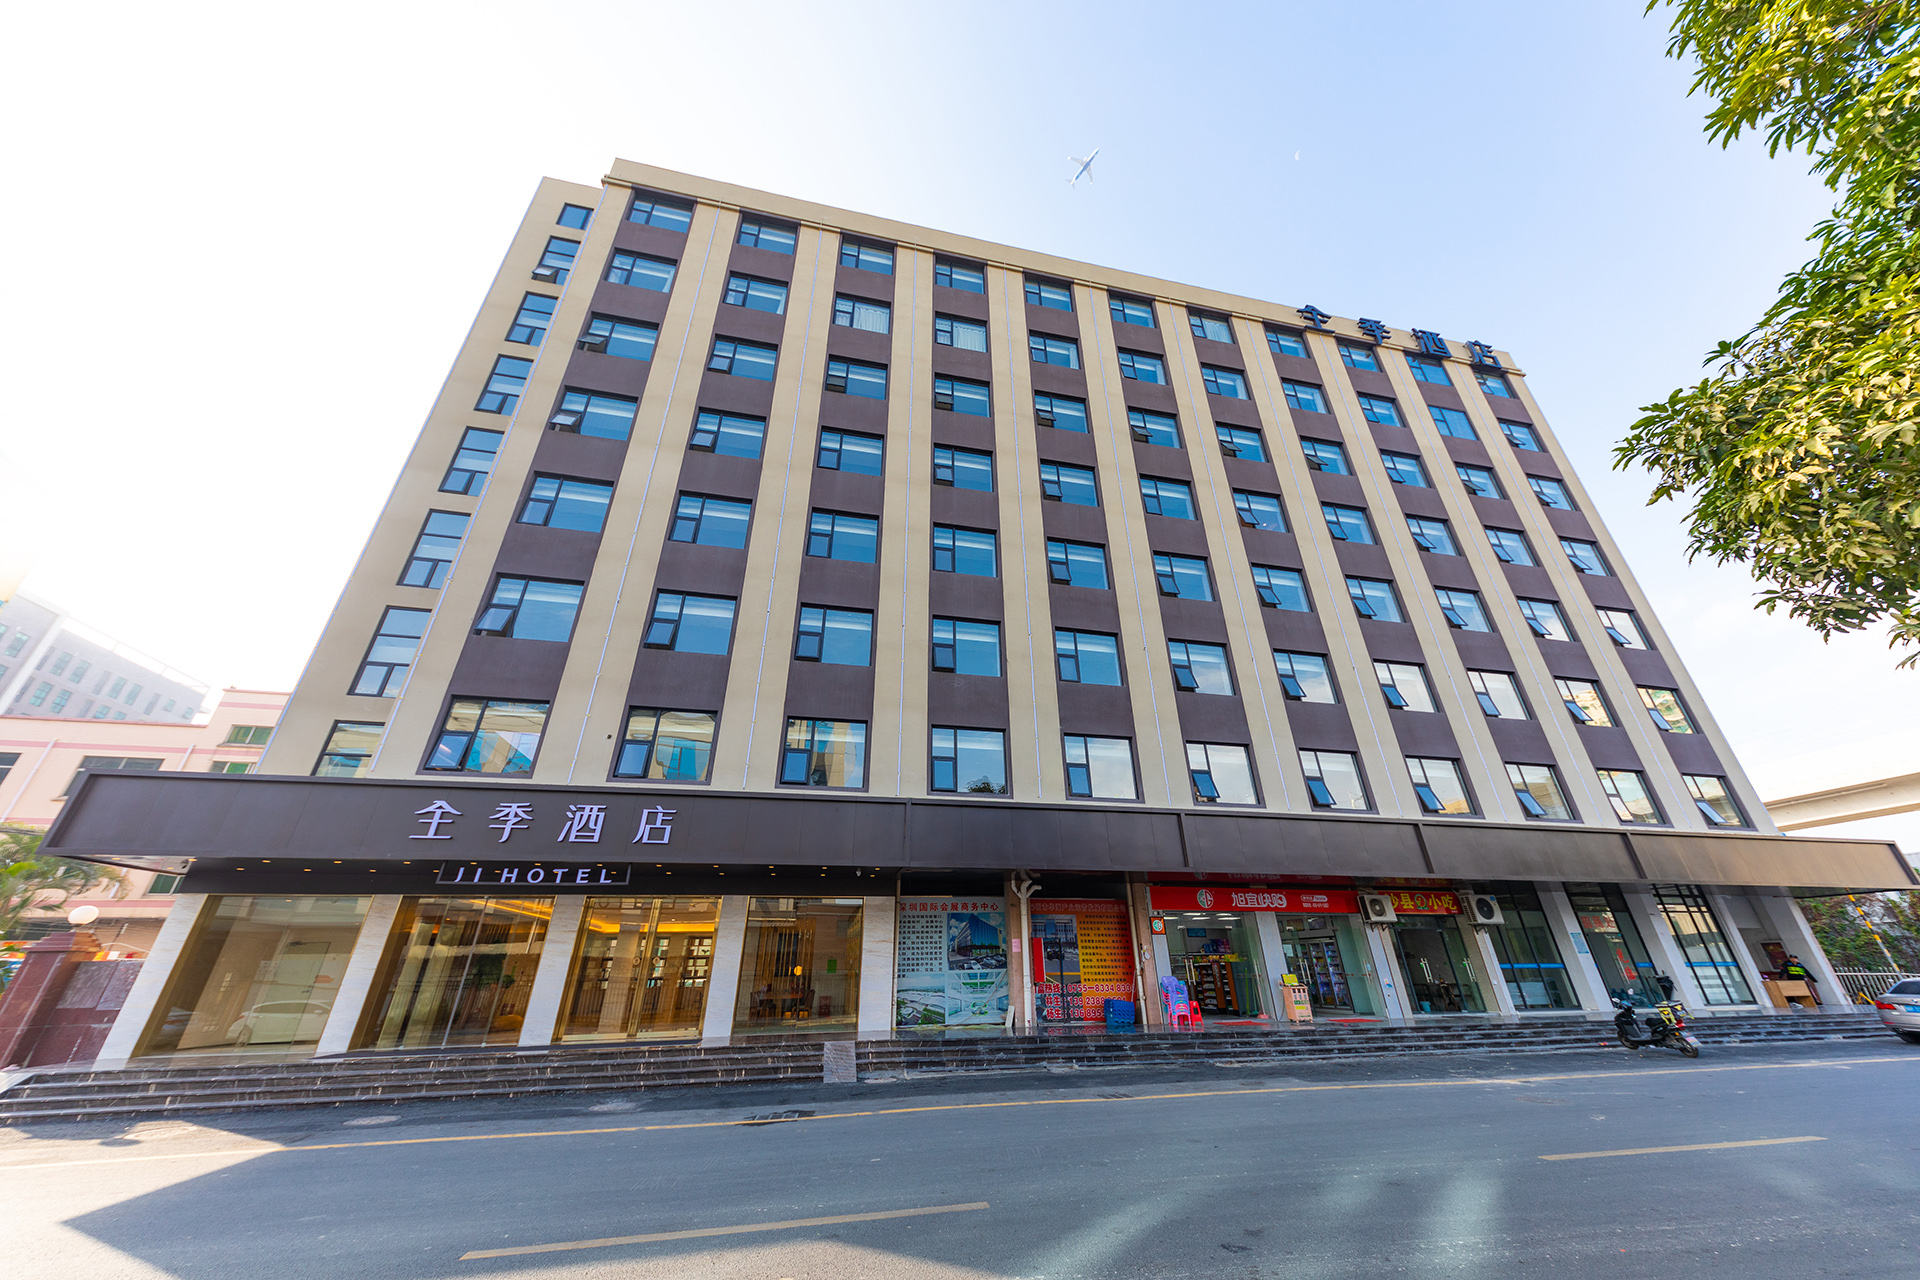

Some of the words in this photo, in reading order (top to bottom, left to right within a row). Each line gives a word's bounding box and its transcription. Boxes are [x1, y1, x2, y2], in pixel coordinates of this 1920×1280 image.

[1296, 304, 1503, 371] 全季酒店
[408, 799, 677, 845] 全季酒店
[454, 867, 482, 883] JI
[500, 867, 614, 885] HOTEL
[899, 902, 999, 912] 深圳国际会展商务中心
[1035, 983, 1066, 994] 富热线:
